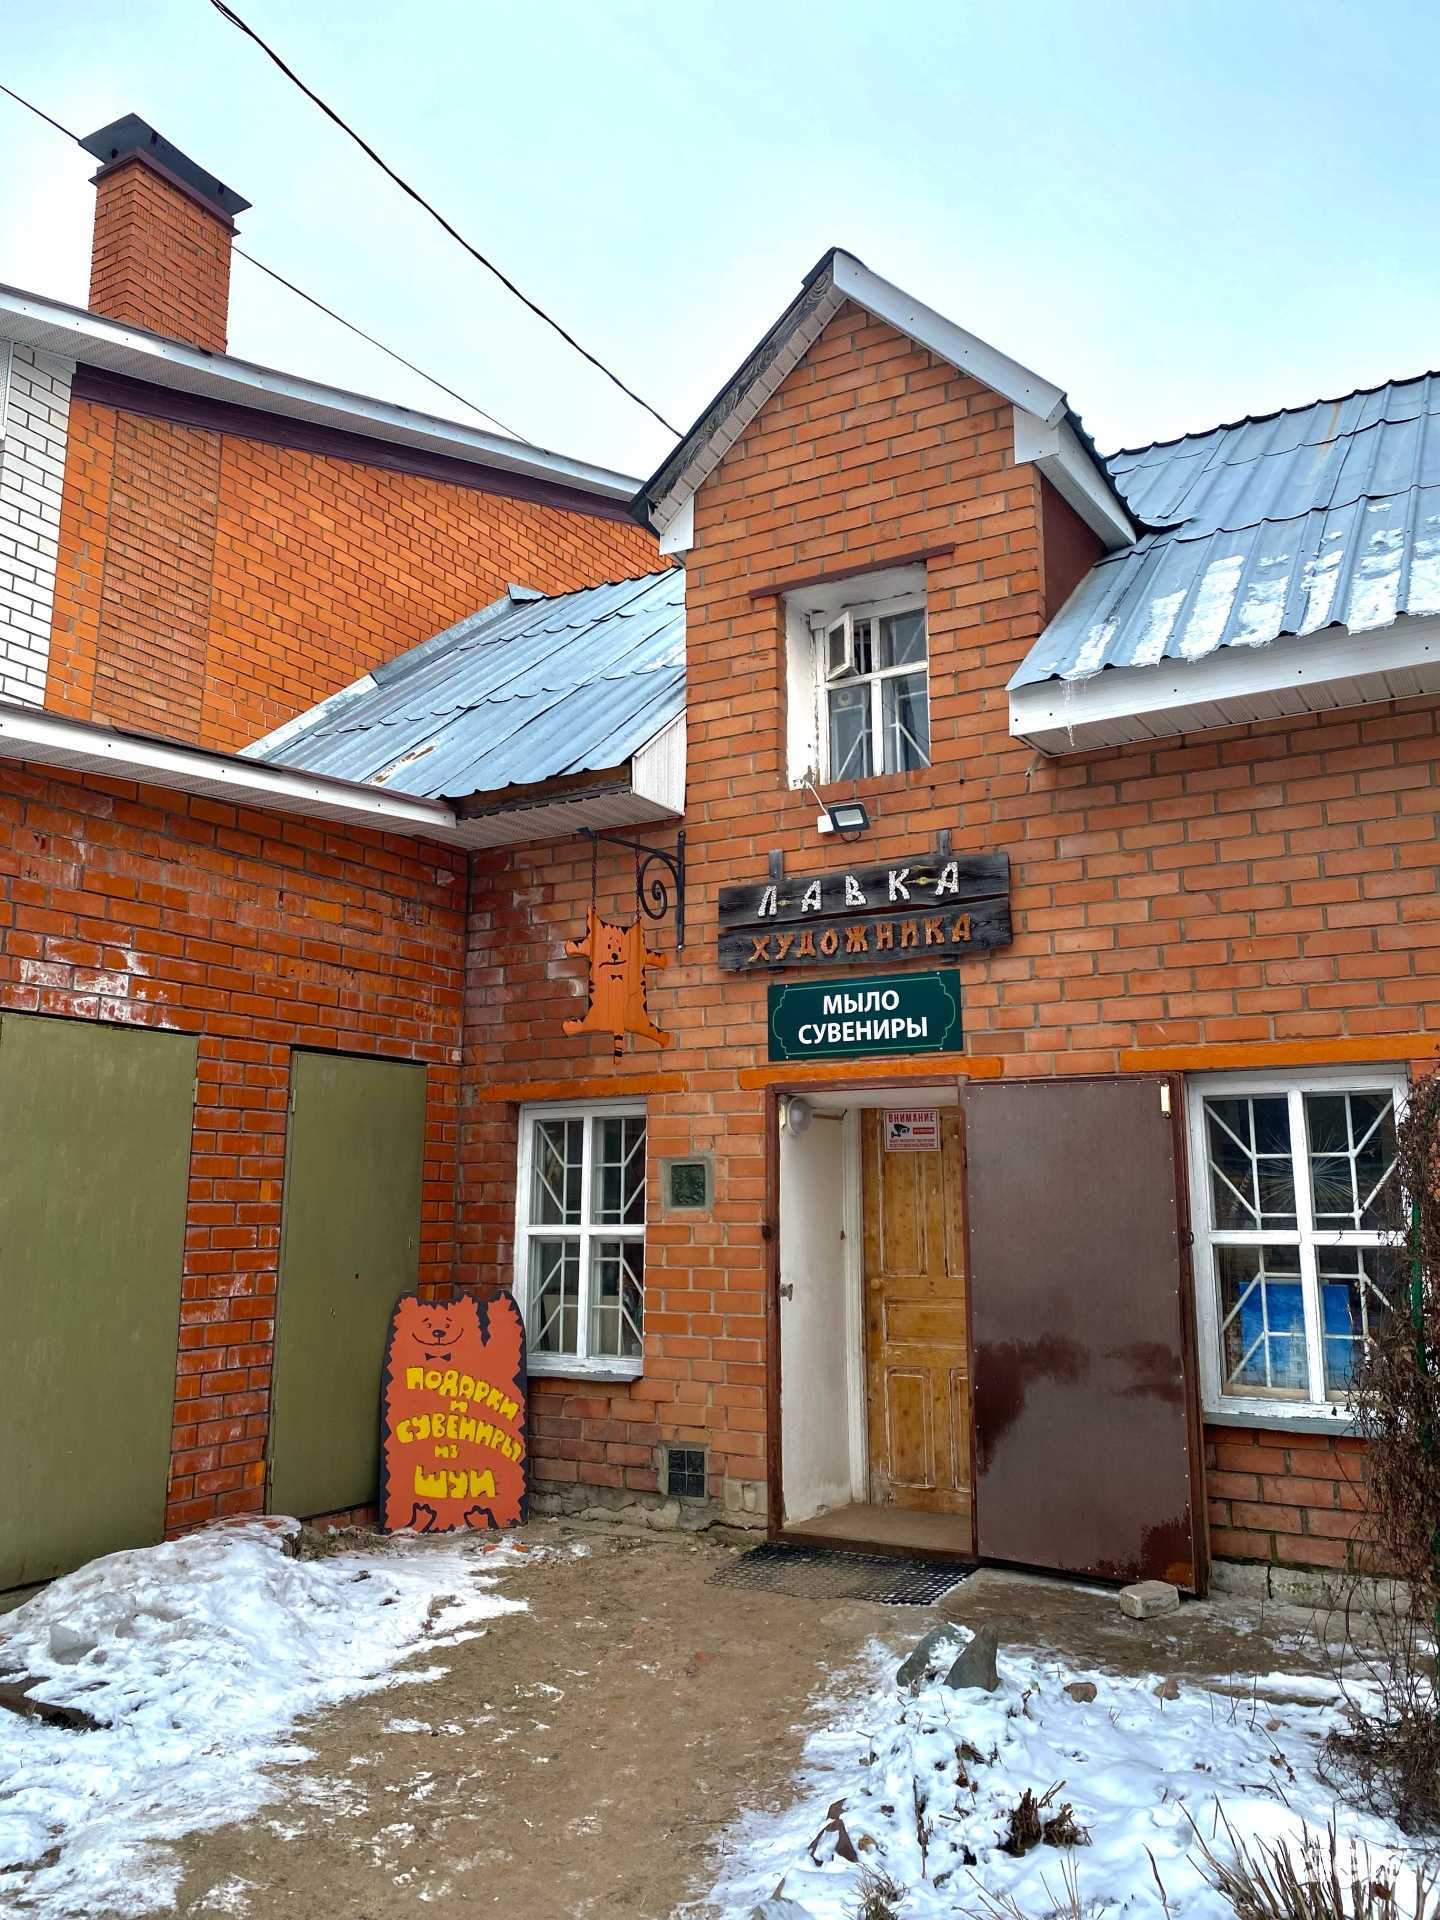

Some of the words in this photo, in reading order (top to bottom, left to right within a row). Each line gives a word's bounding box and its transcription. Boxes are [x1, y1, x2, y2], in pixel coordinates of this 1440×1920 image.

[757, 861, 960, 918] ЛАВКА
[749, 913, 972, 962] ХУДОЖНИКА
[822, 990, 900, 1016] МЫЛО
[798, 1016, 928, 1045] СУВЕНИРЫ
[888, 1112, 935, 1123] ВНИМАНИЕ
[406, 1367, 519, 1420] ПОДАРКИ
[396, 1413, 522, 1461] СУВЕНИРЫ
[435, 1444, 458, 1458] ИЗ
[414, 1465, 496, 1499] ШУИ
